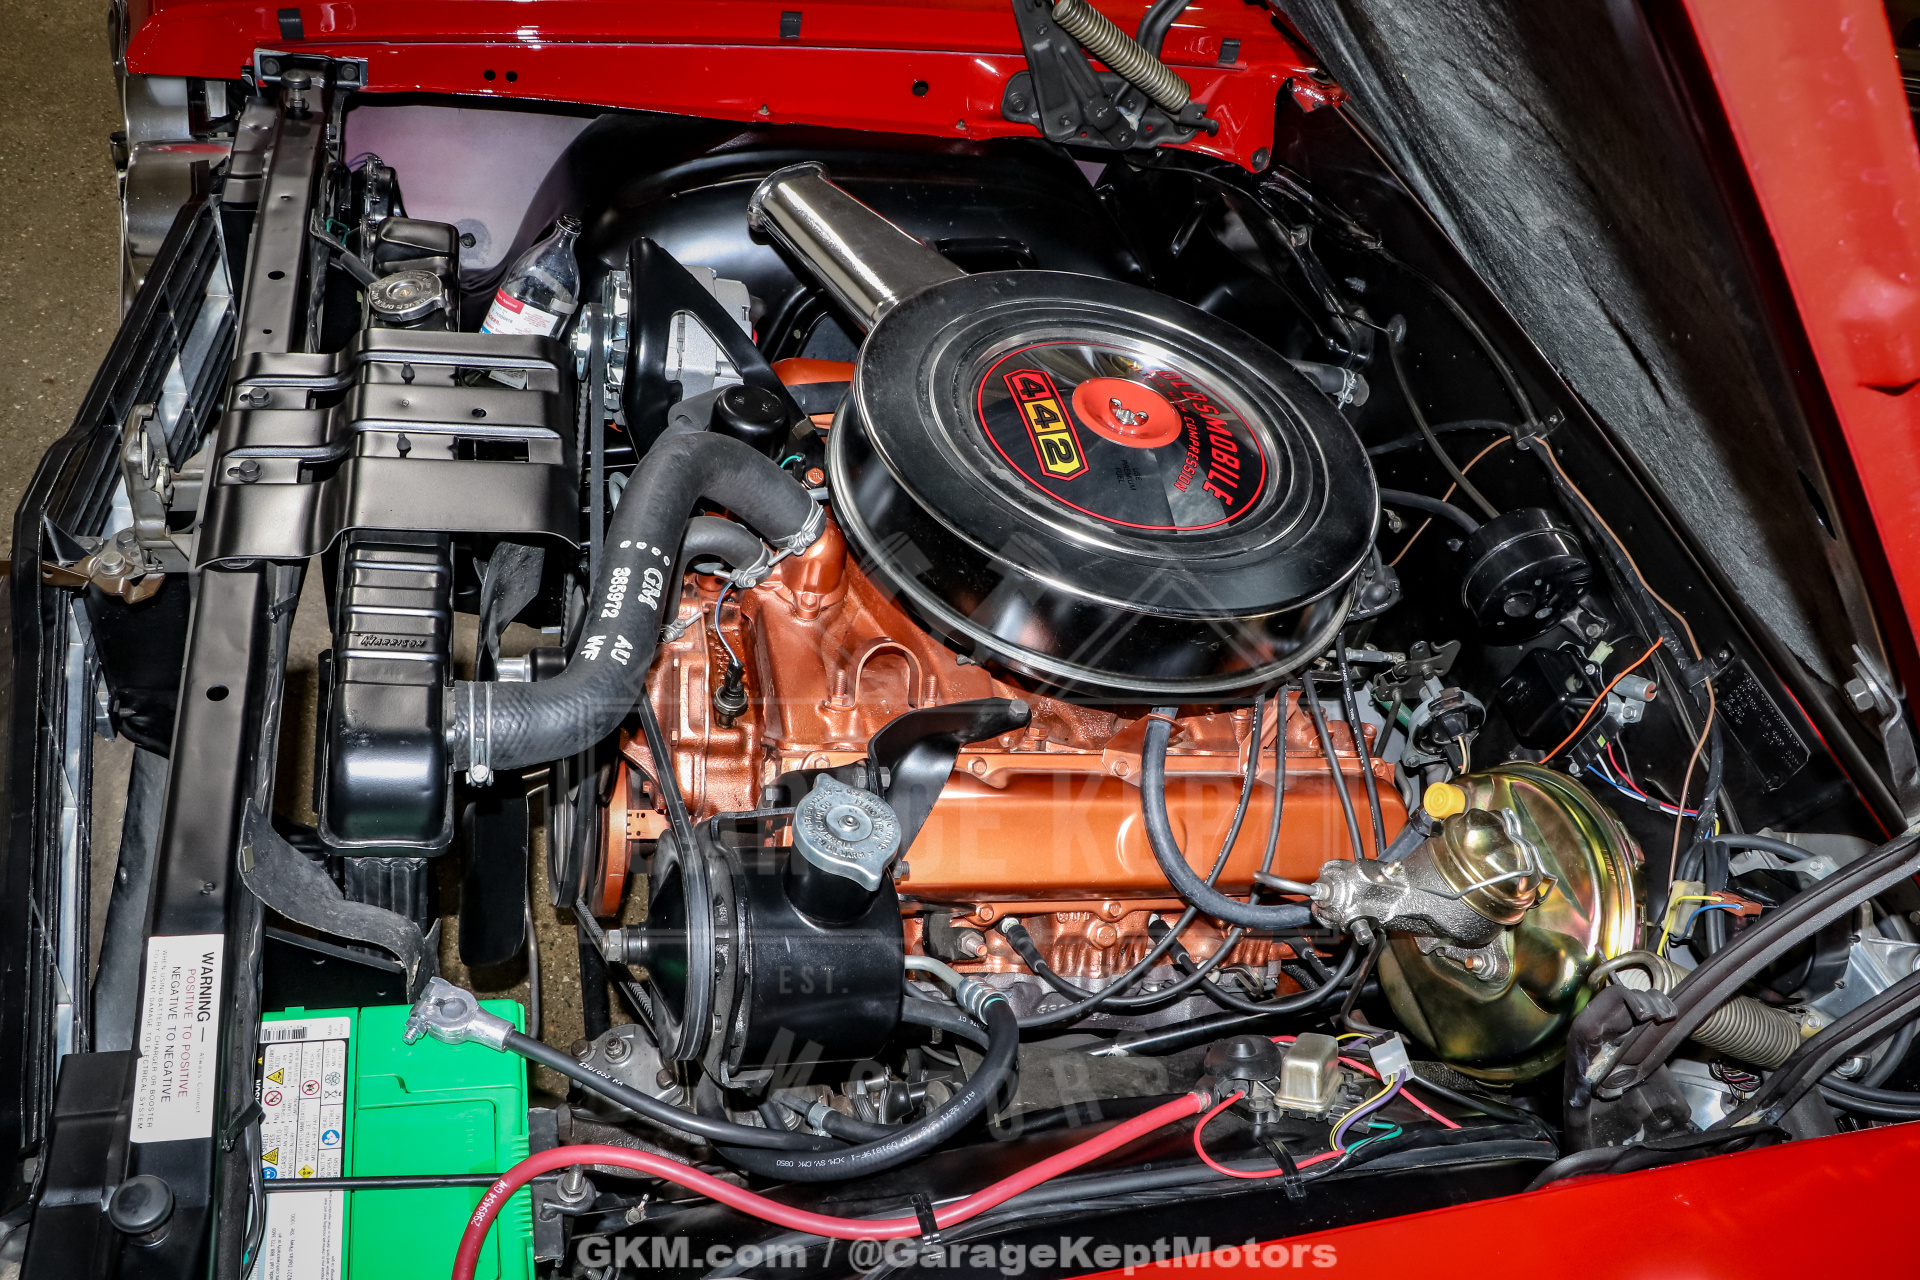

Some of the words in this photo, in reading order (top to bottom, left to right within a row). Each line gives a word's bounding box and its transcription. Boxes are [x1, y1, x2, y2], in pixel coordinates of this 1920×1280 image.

[1017, 376, 1076, 467] 442
[1156, 370, 1240, 506] OLDSMOBILE
[1173, 416, 1200, 493] COMPRESSION
[1114, 467, 1125, 484] FUEL
[1120, 459, 1137, 491] PREMIUM
[1132, 467, 1143, 481] USE
[637, 567, 664, 611] GM
[580, 634, 607, 661] WF
[610, 634, 633, 666] AU
[154, 949, 159, 959] TO
[150, 961, 158, 994] PREVENT
[168, 966, 181, 1020] NEGATIVE
[183, 968, 196, 1019] POSITIVE
[197, 951, 214, 1022] WARNING
[146, 997, 155, 1028] DAMAGE
[156, 997, 164, 1032] BATTERY
[145, 1032, 151, 1042] TO
[166, 1025, 177, 1041] TO
[182, 1024, 192, 1040] TO
[140, 1045, 150, 1092] ELECTRICAL
[151, 1035, 160, 1072] CHARGER
[197, 1052, 205, 1079] Always
[150, 1075, 157, 1086] OR
[161, 1045, 174, 1103] NEGATIVE
[177, 1044, 190, 1098] POSITIVE
[137, 1096, 146, 1129] SYSTEM
[147, 1089, 156, 1128] BOOSTER
[195, 1082, 204, 1113] Connect
[939, 1104, 961, 1123] 3271
[962, 1090, 976, 1106] AIT
[471, 1192, 497, 1228] 2989454
[494, 1178, 509, 1196] GW
